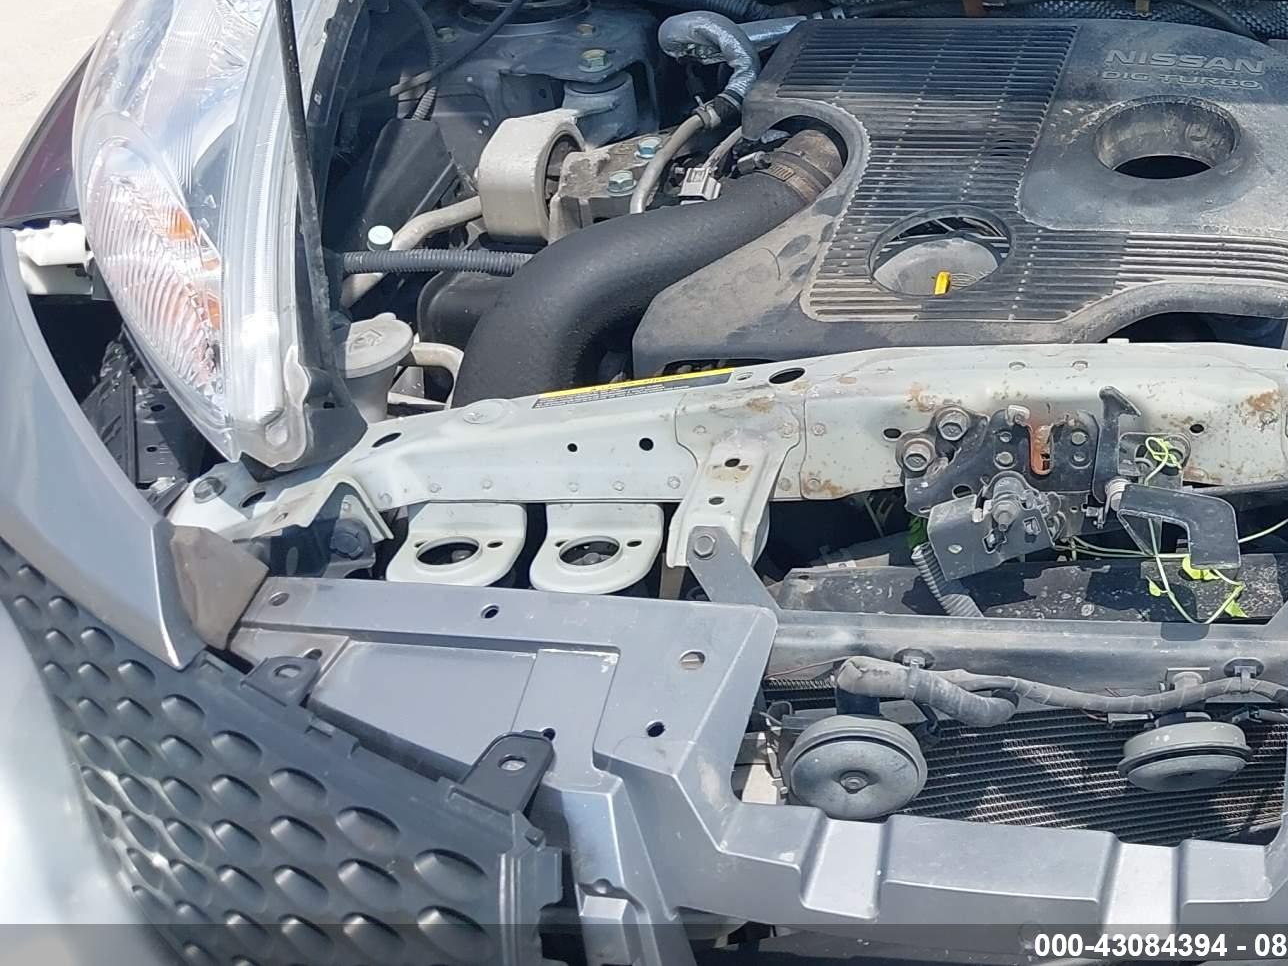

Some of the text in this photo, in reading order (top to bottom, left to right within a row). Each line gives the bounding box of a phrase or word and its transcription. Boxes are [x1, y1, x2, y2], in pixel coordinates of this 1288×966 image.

[1105, 49, 1264, 74] NISSAN
[1103, 71, 1263, 90] DIG TURBO
